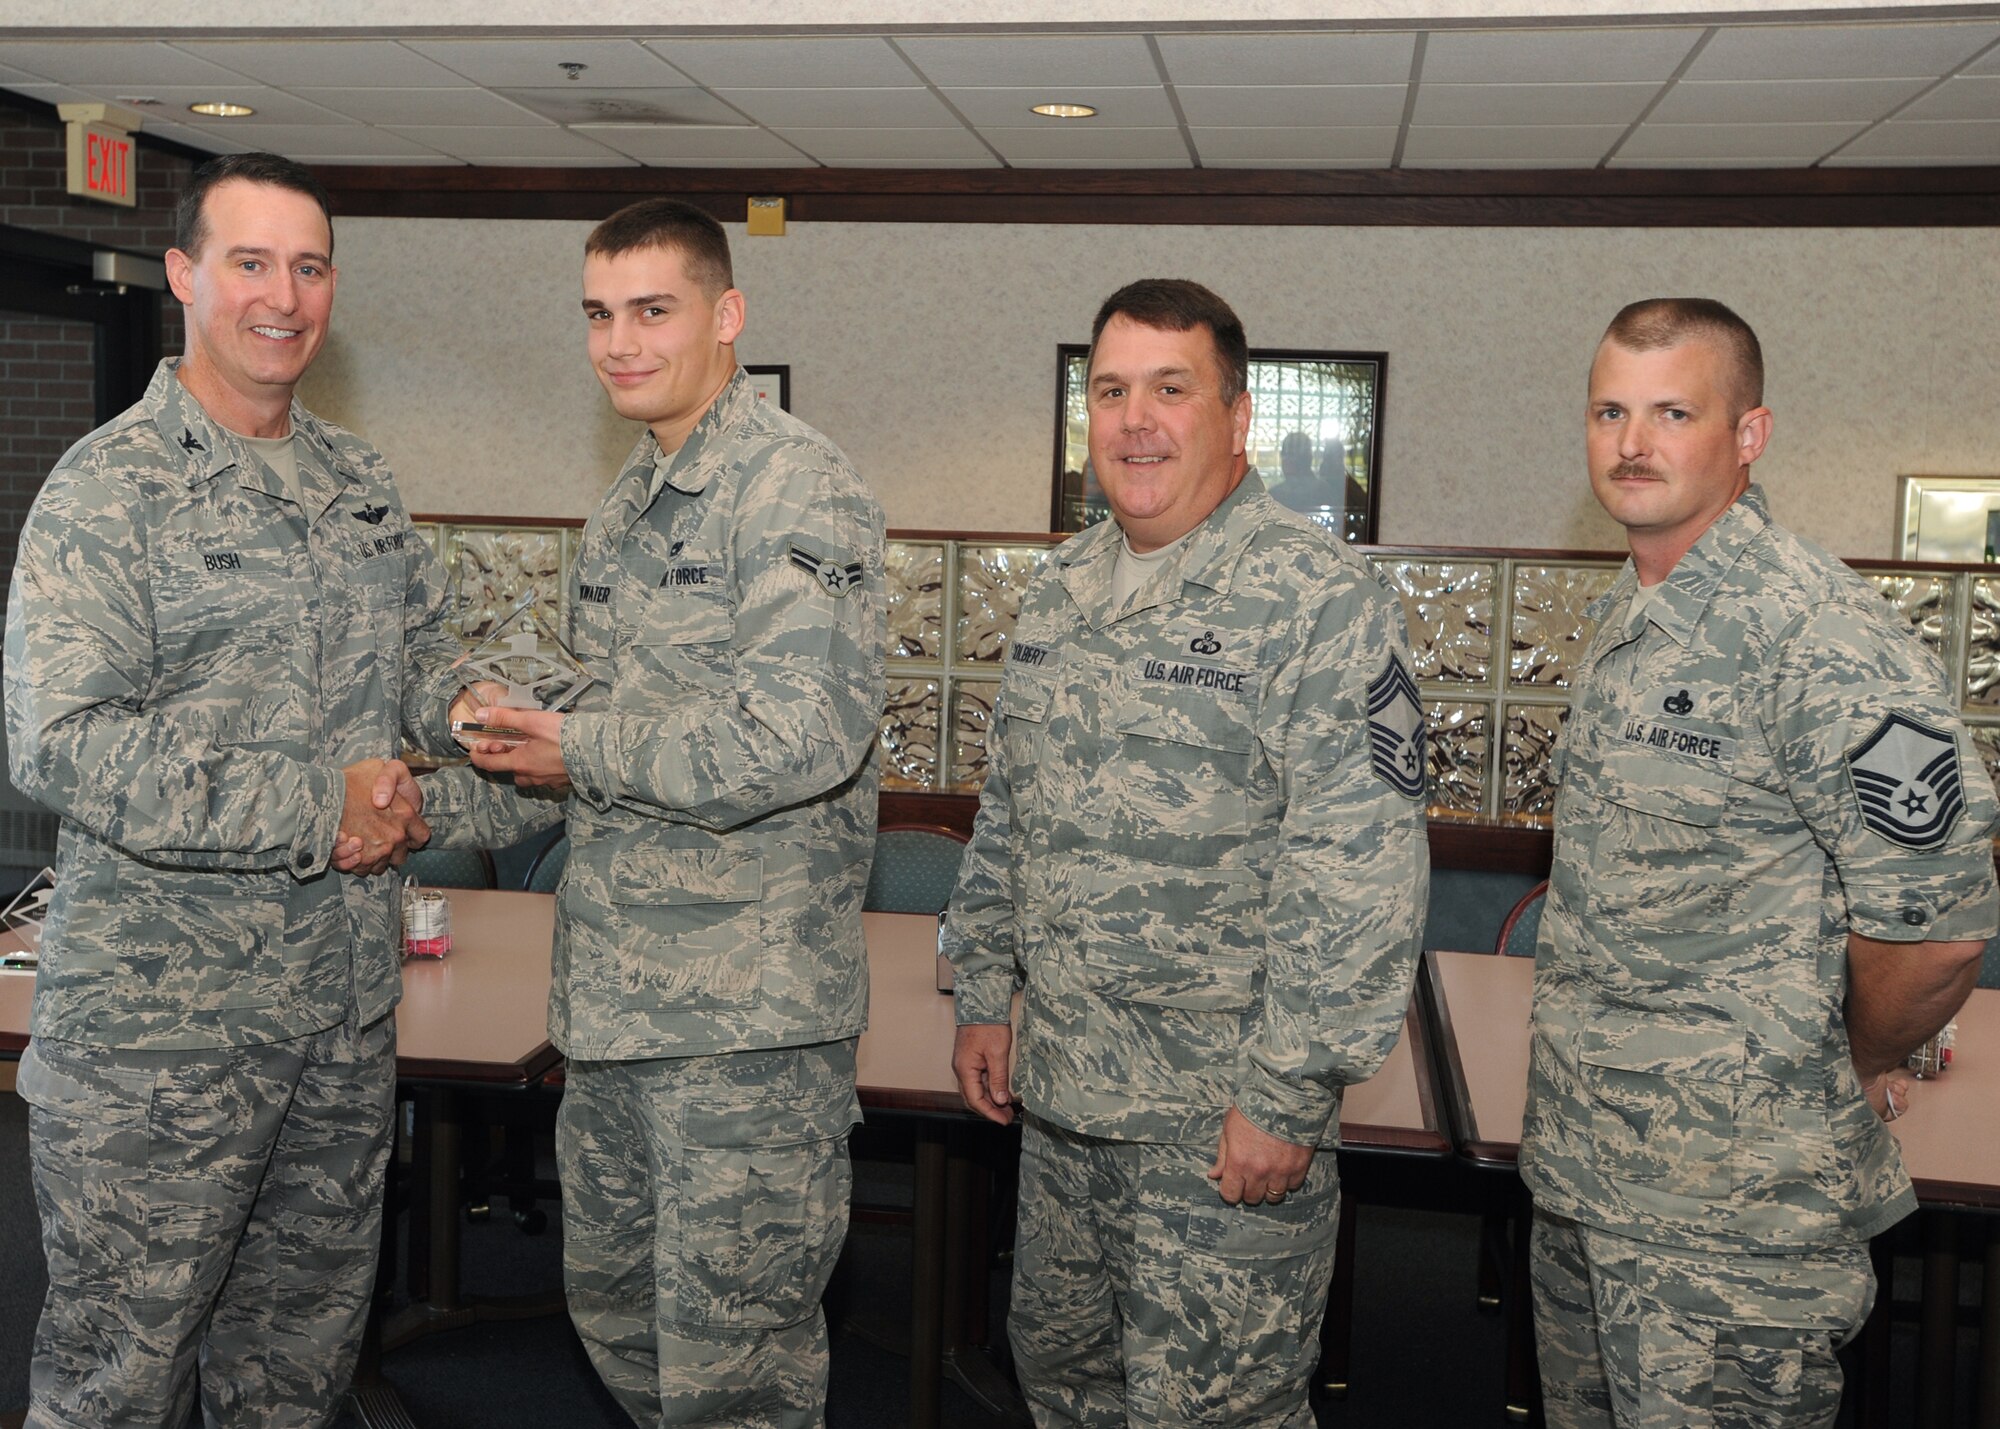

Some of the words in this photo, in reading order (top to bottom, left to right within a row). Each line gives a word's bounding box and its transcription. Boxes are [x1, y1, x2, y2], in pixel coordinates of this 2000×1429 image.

[87, 132, 128, 197] EXIT
[204, 552, 241, 571] BUSH
[669, 567, 709, 586] FORCE
[1144, 660, 1166, 681] U.S.
[1167, 664, 1195, 685] AIR
[1195, 668, 1247, 693] FORCE
[1625, 722, 1644, 743] U.S.
[1647, 726, 1669, 748] AIR
[1669, 731, 1721, 759] FORCE
